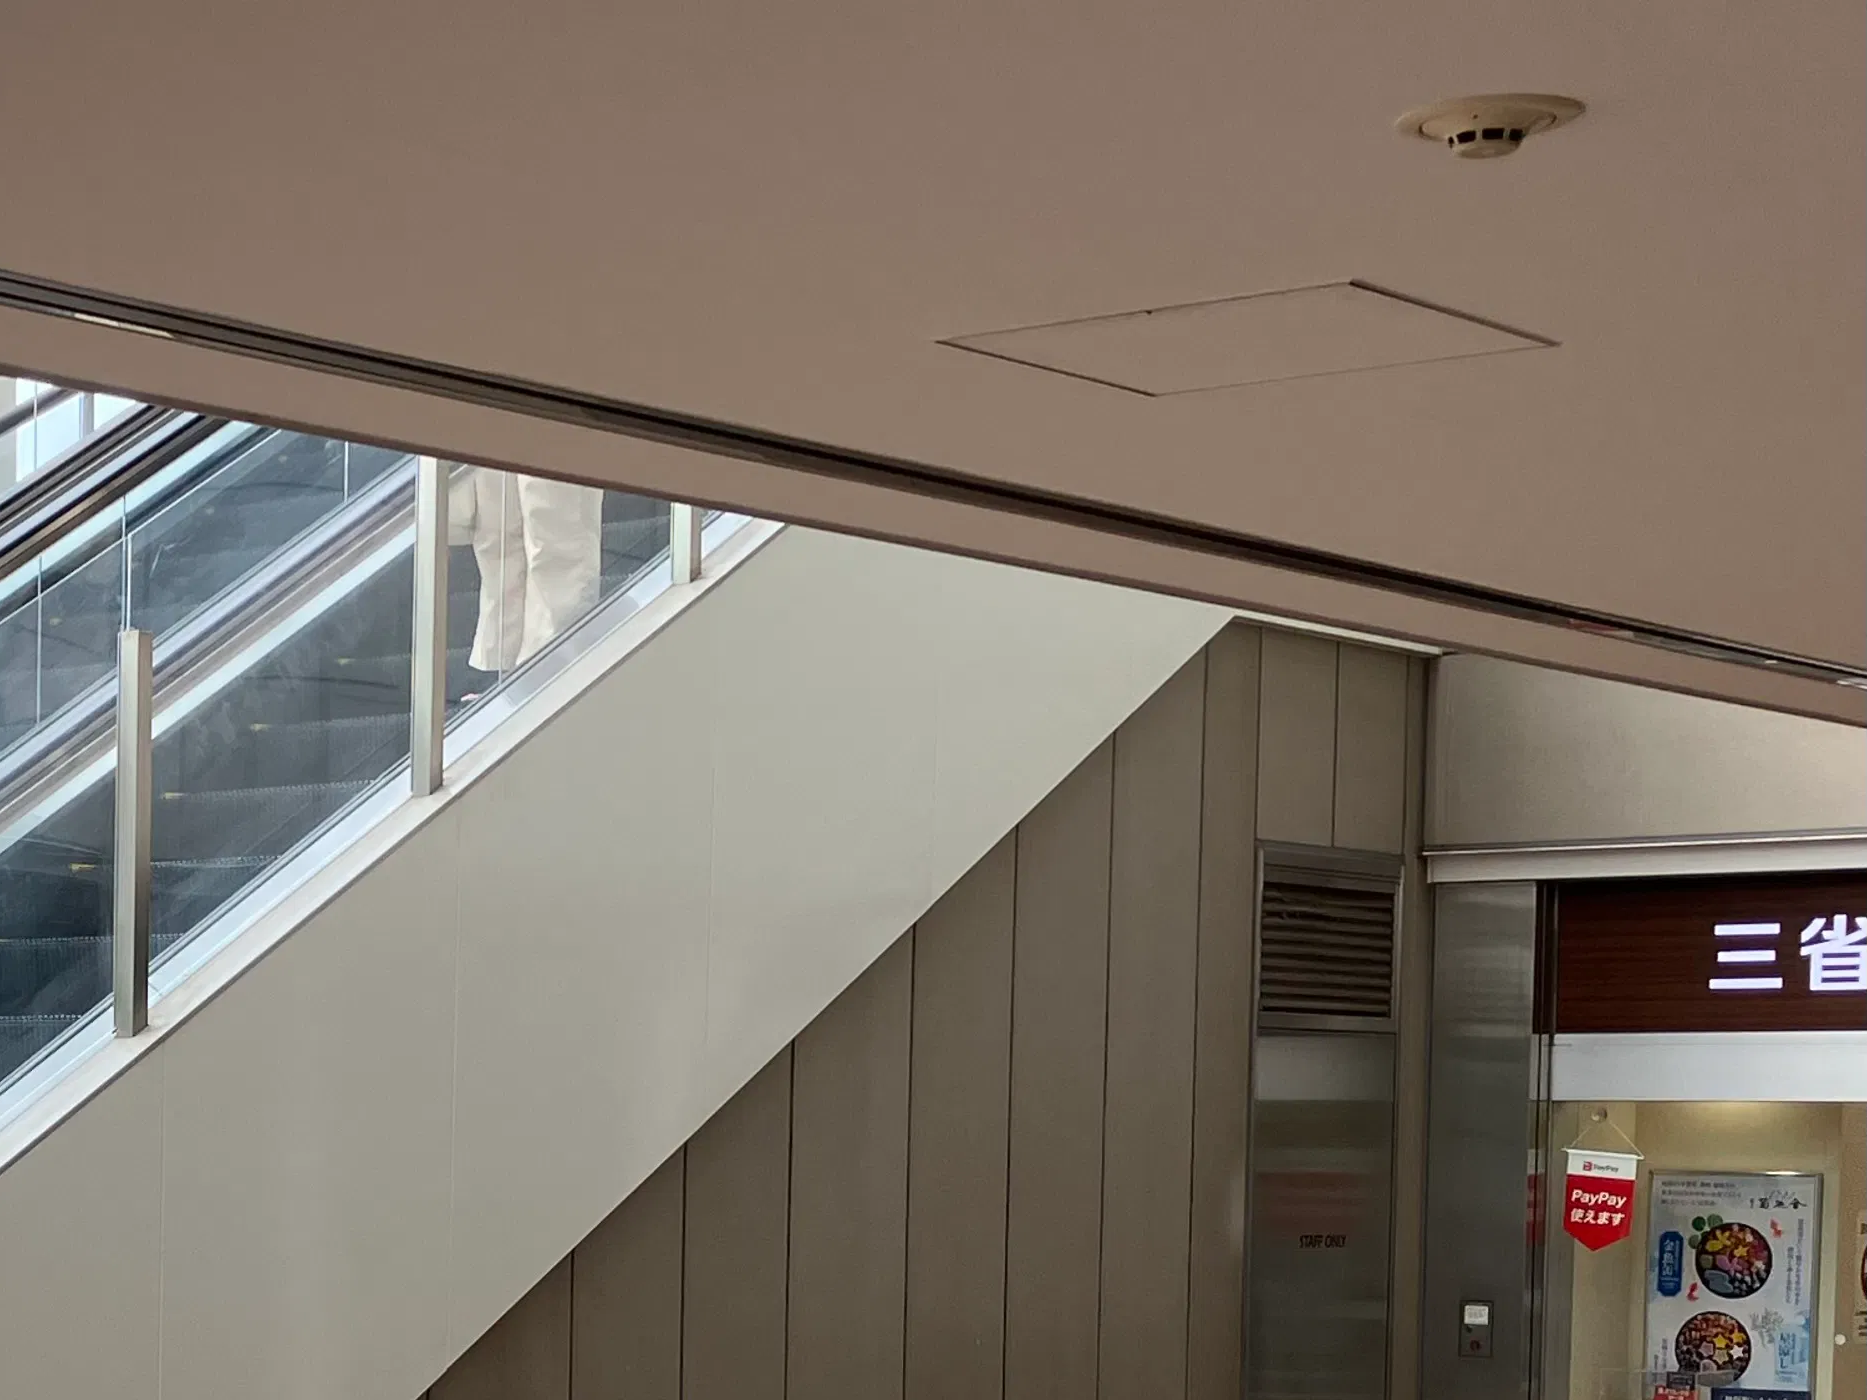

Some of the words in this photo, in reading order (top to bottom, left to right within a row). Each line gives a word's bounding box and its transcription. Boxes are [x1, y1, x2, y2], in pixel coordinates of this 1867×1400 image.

[1571, 1189, 1627, 1208] PayPay
[1570, 1208, 1625, 1226] 使えます
[1300, 1234, 1323, 1248] STAFF
[1325, 1234, 1346, 1248] ONLY
